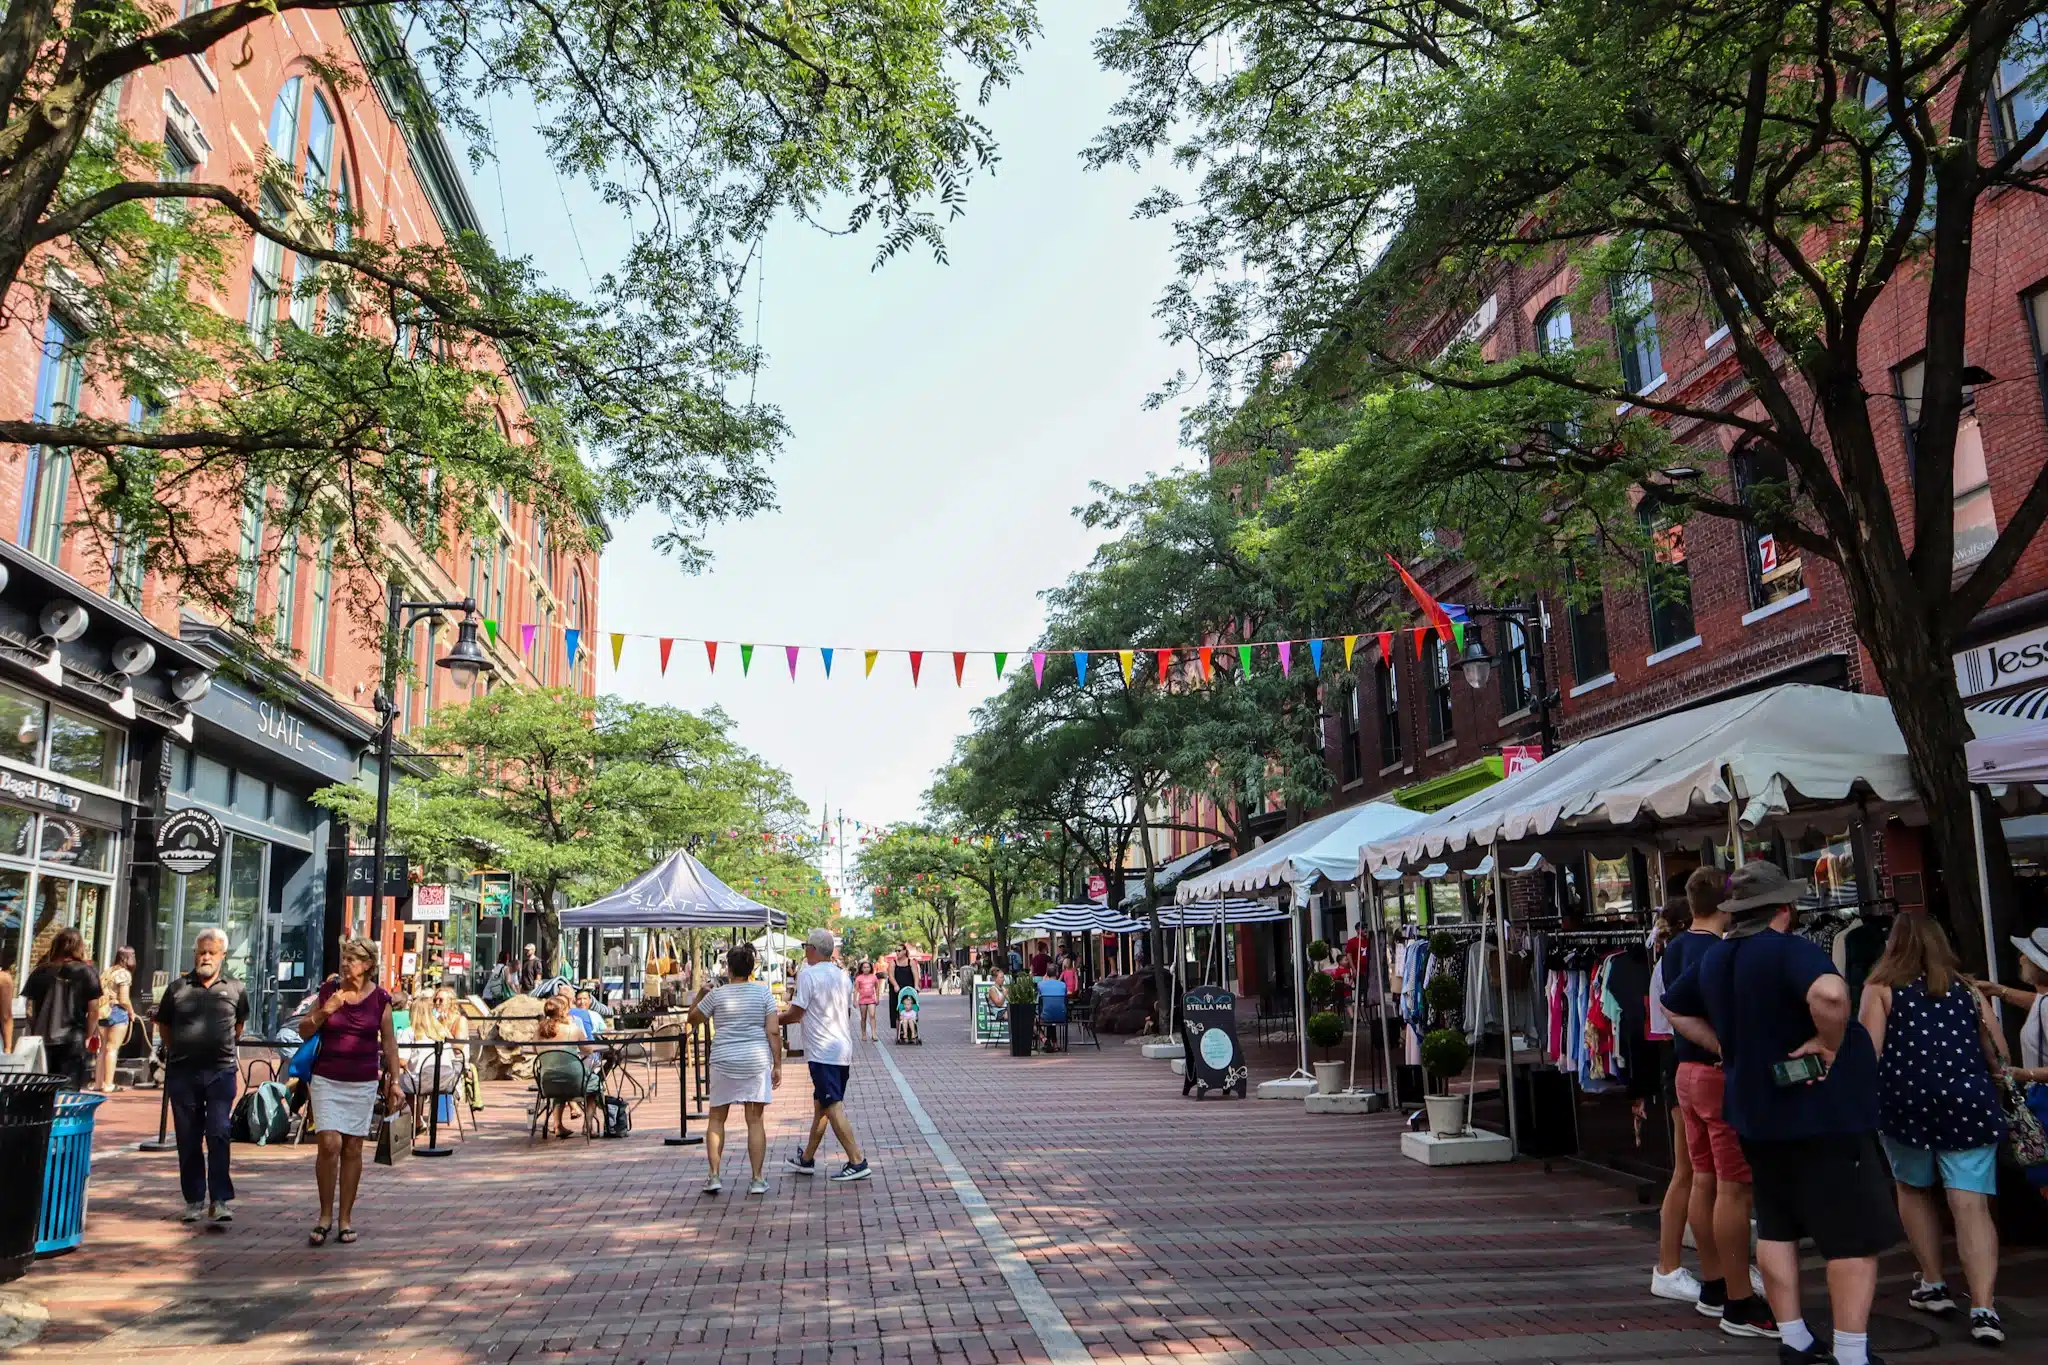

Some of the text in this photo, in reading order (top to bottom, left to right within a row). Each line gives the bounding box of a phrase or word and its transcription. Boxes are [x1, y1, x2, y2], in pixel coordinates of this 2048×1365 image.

[1760, 539, 1776, 569] Z
[1988, 643, 2048, 687] Jes
[257, 701, 305, 752] SLATE
[0, 771, 81, 813] Bagel Bakery
[156, 809, 220, 847] Burlington Bagel Bakery
[353, 867, 401, 881] SLTE
[627, 893, 709, 911] SLATE
[1216, 1003, 1232, 1011] MAE
